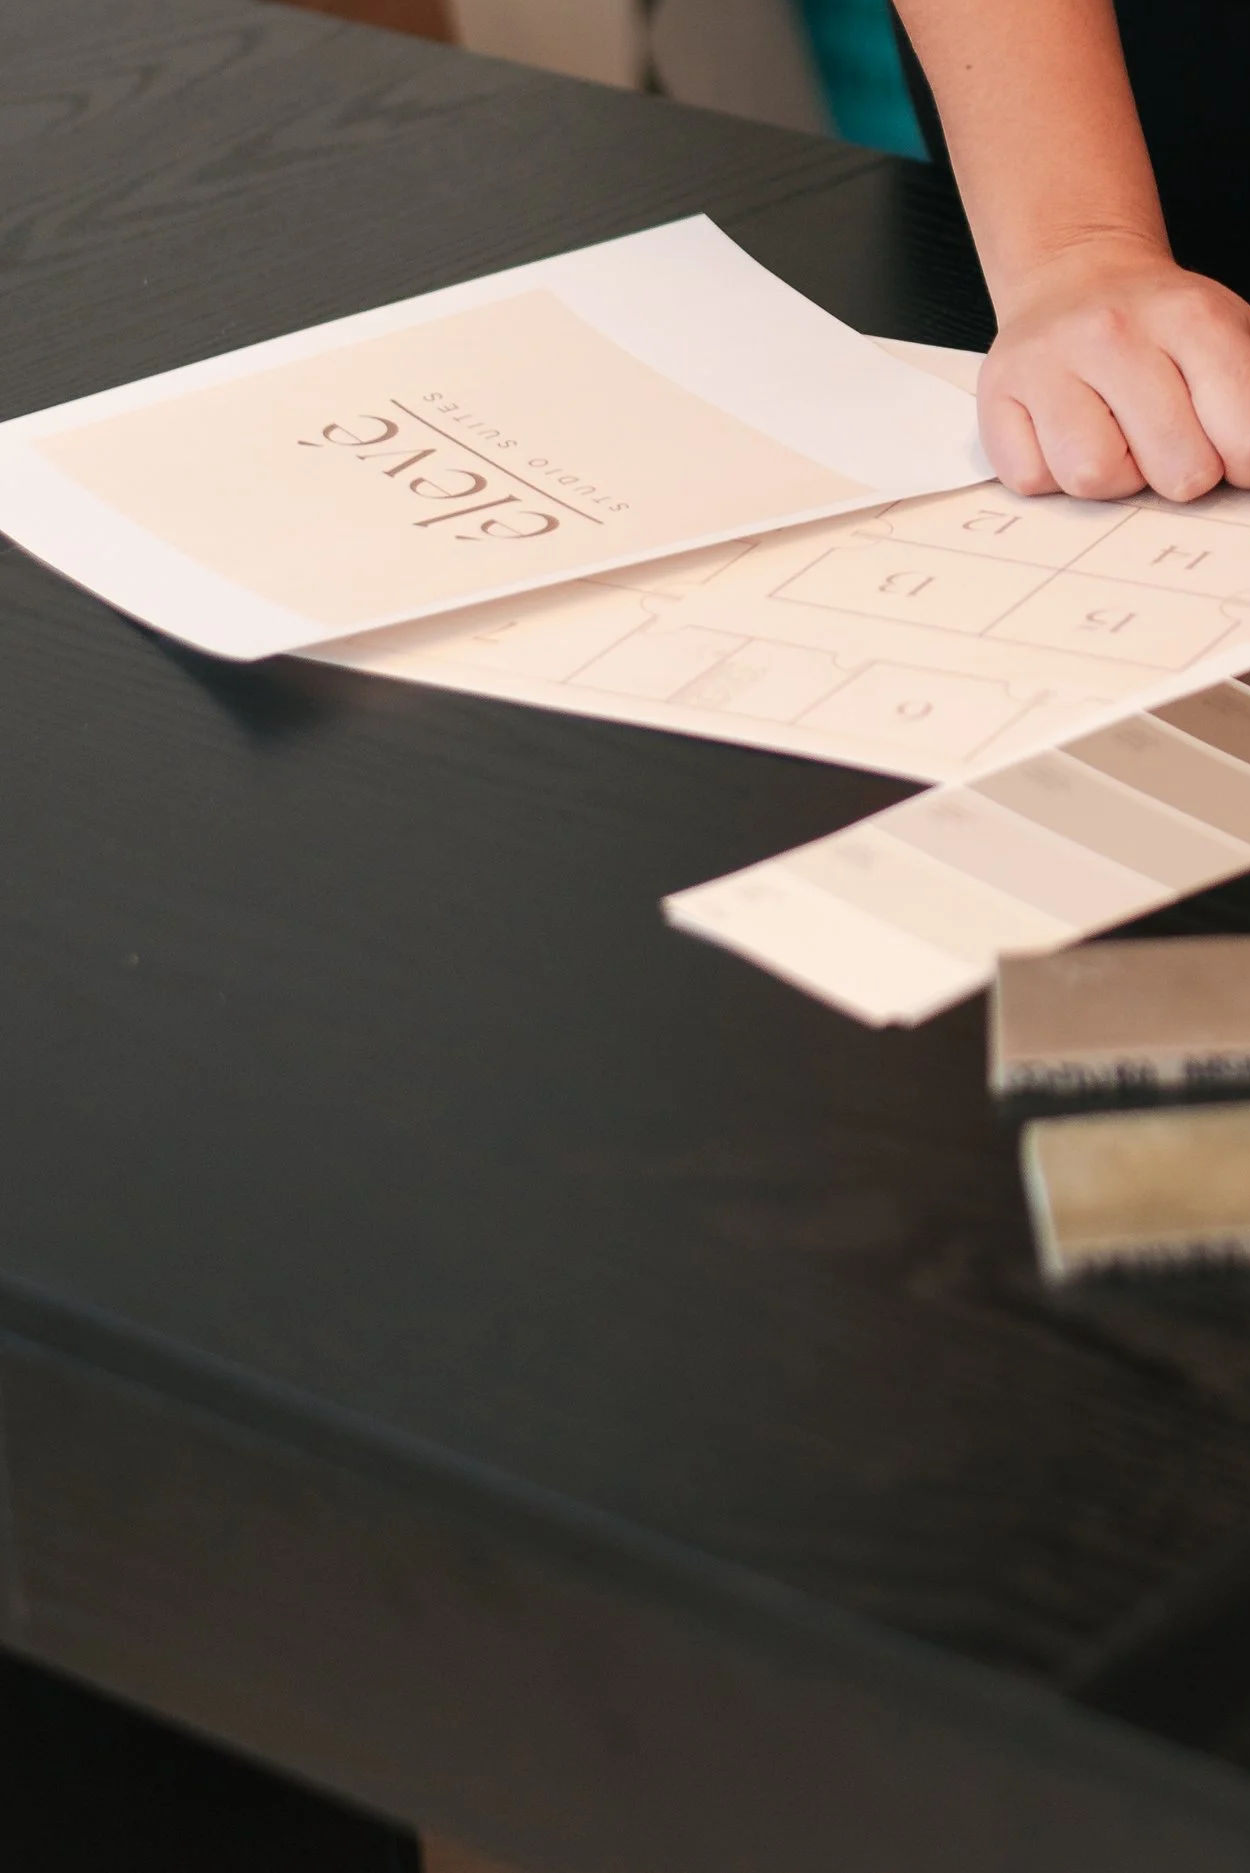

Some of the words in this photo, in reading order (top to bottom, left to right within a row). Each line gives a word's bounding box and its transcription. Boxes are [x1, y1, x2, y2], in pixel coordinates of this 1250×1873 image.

[422, 391, 519, 450] SUITES
[296, 414, 561, 541] élevé
[527, 458, 630, 513] STUDIO
[962, 508, 1023, 535] 12
[1150, 544, 1213, 571] 14
[877, 571, 936, 598] 13
[1078, 608, 1138, 635] 15
